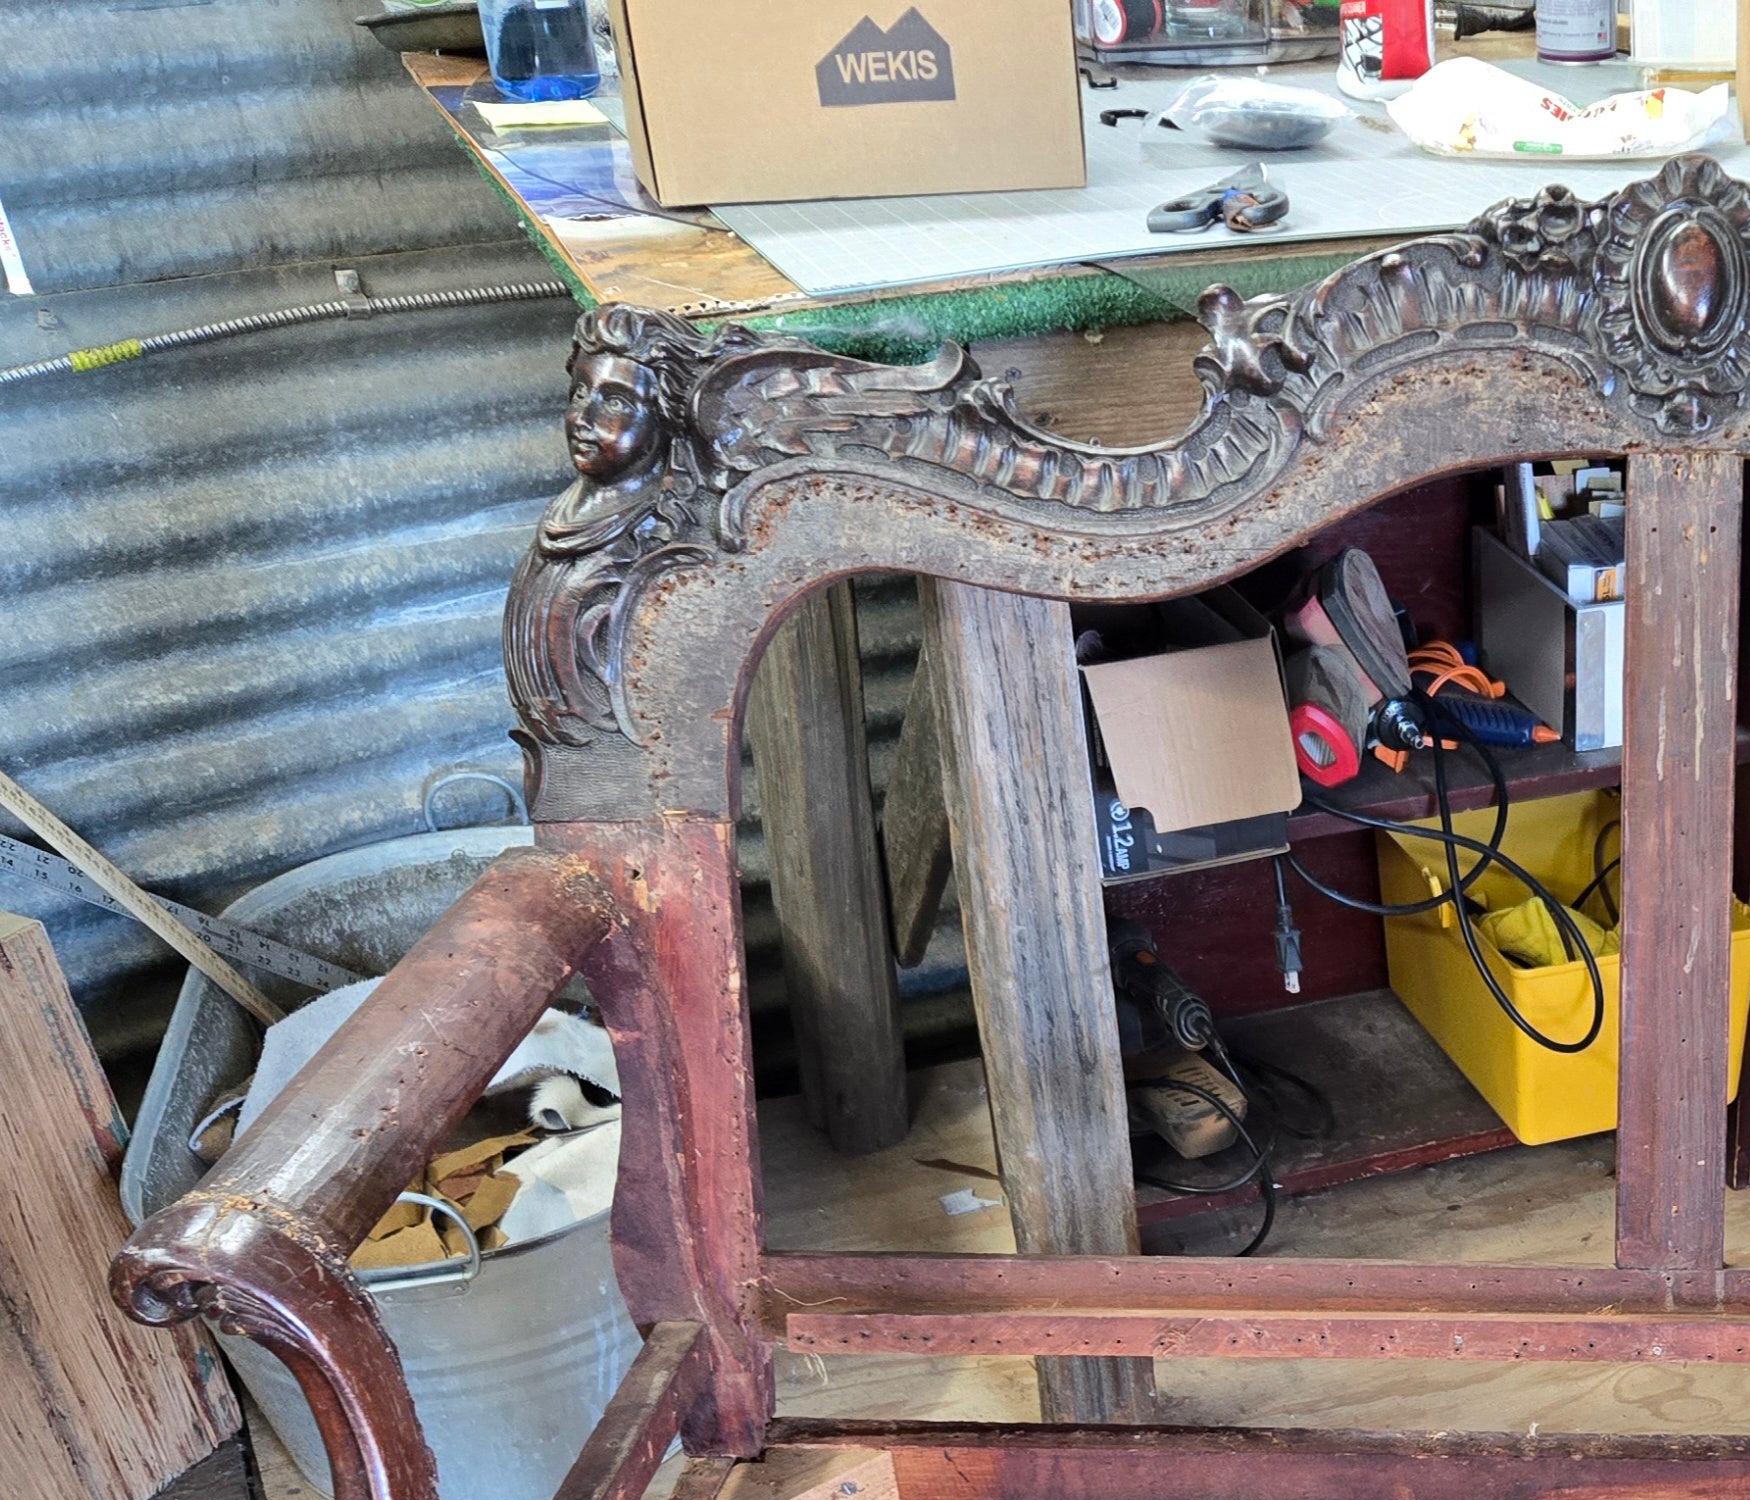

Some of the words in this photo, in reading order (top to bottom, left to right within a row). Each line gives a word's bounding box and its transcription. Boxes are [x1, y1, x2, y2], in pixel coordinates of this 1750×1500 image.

[835, 49, 938, 84] WEKIS
[35, 869, 48, 880] 15
[69, 882, 82, 893] 16
